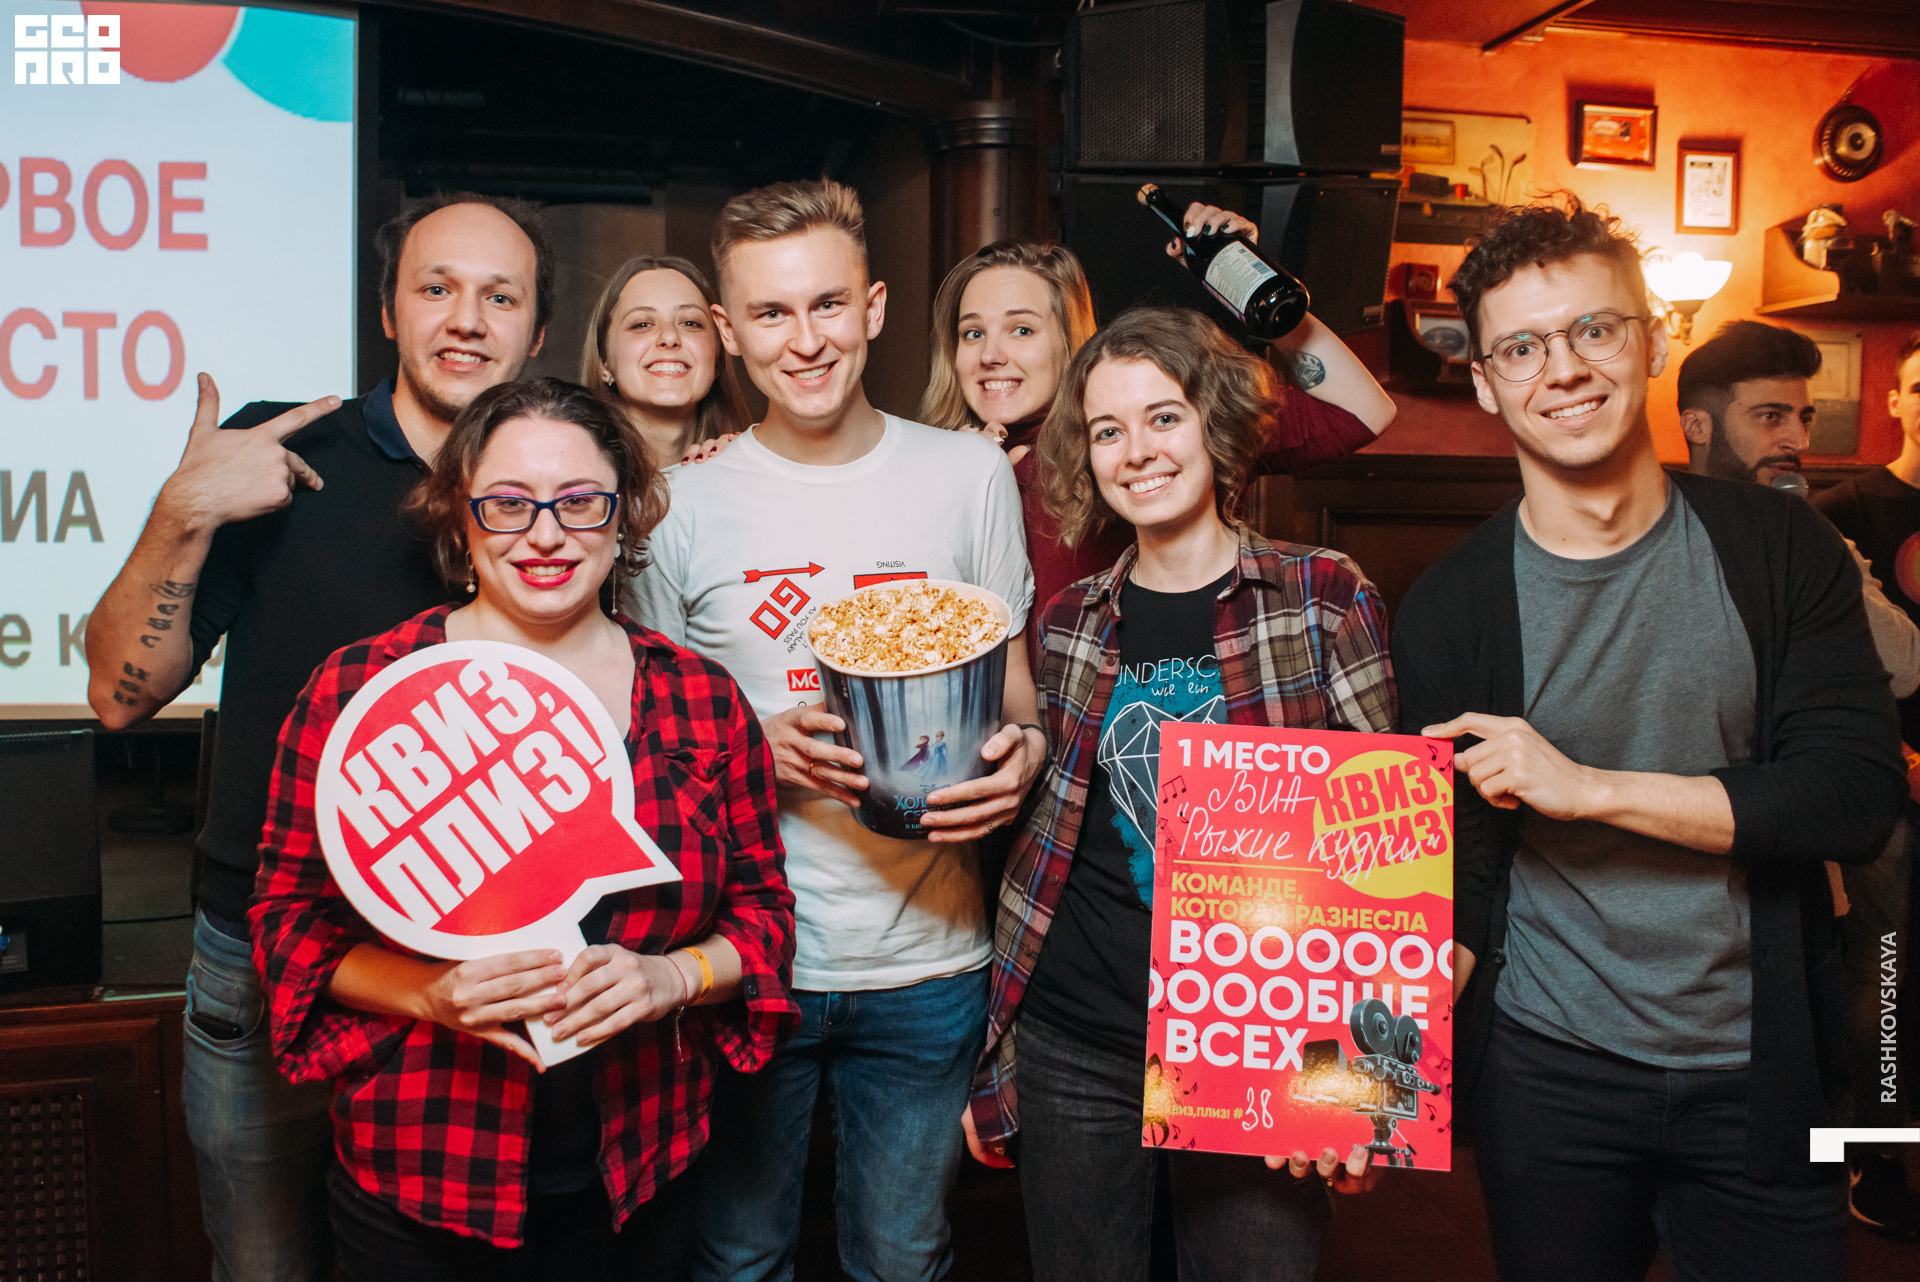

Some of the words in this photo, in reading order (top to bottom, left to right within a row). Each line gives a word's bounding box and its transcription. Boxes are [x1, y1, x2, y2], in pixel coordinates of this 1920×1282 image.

[0, 157, 208, 251] ВОЕ
[783, 628, 798, 645] PASS
[797, 615, 810, 629] YOU
[1151, 681, 1176, 696] wie
[1188, 678, 1209, 694] ein
[1177, 739, 1192, 767] 1
[1203, 740, 1331, 774] МЕСТО
[1319, 759, 1448, 827] КВИЗ,
[1172, 872, 1304, 903] КОМАНДЕ,
[1296, 904, 1429, 933] РАЗНЕСЛА
[1165, 1018, 1308, 1071] ВСЕХ
